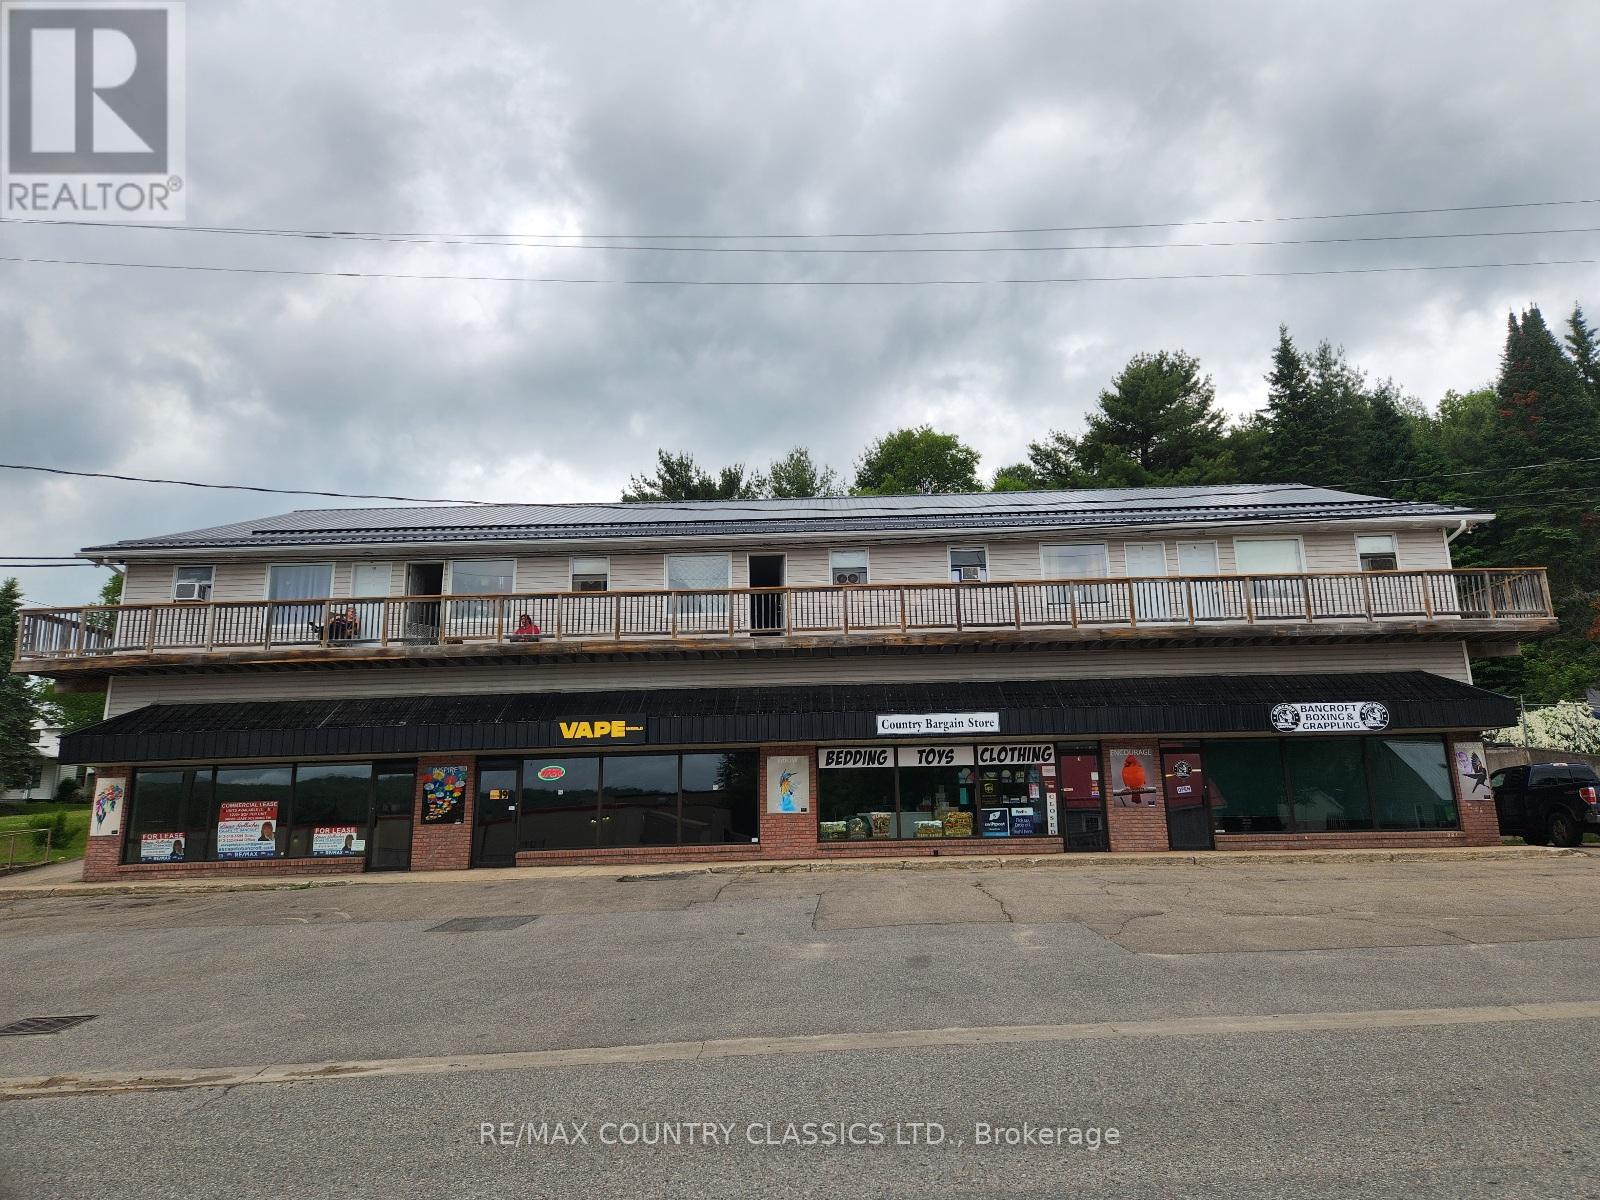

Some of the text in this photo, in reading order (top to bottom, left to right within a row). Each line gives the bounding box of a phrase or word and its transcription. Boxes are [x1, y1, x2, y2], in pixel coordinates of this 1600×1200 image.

[1300, 704, 1357, 713] BANCROFT
[1305, 712, 1354, 721] BOXING &
[559, 720, 625, 739] VAPE
[881, 717, 995, 733] Country Bargain Store
[1302, 721, 1361, 730] GRAPPLING
[825, 749, 888, 766] BEDDING
[917, 748, 955, 765] TOYS
[979, 746, 1053, 764] CLOTHING
[1048, 794, 1056, 835] CLOSED
